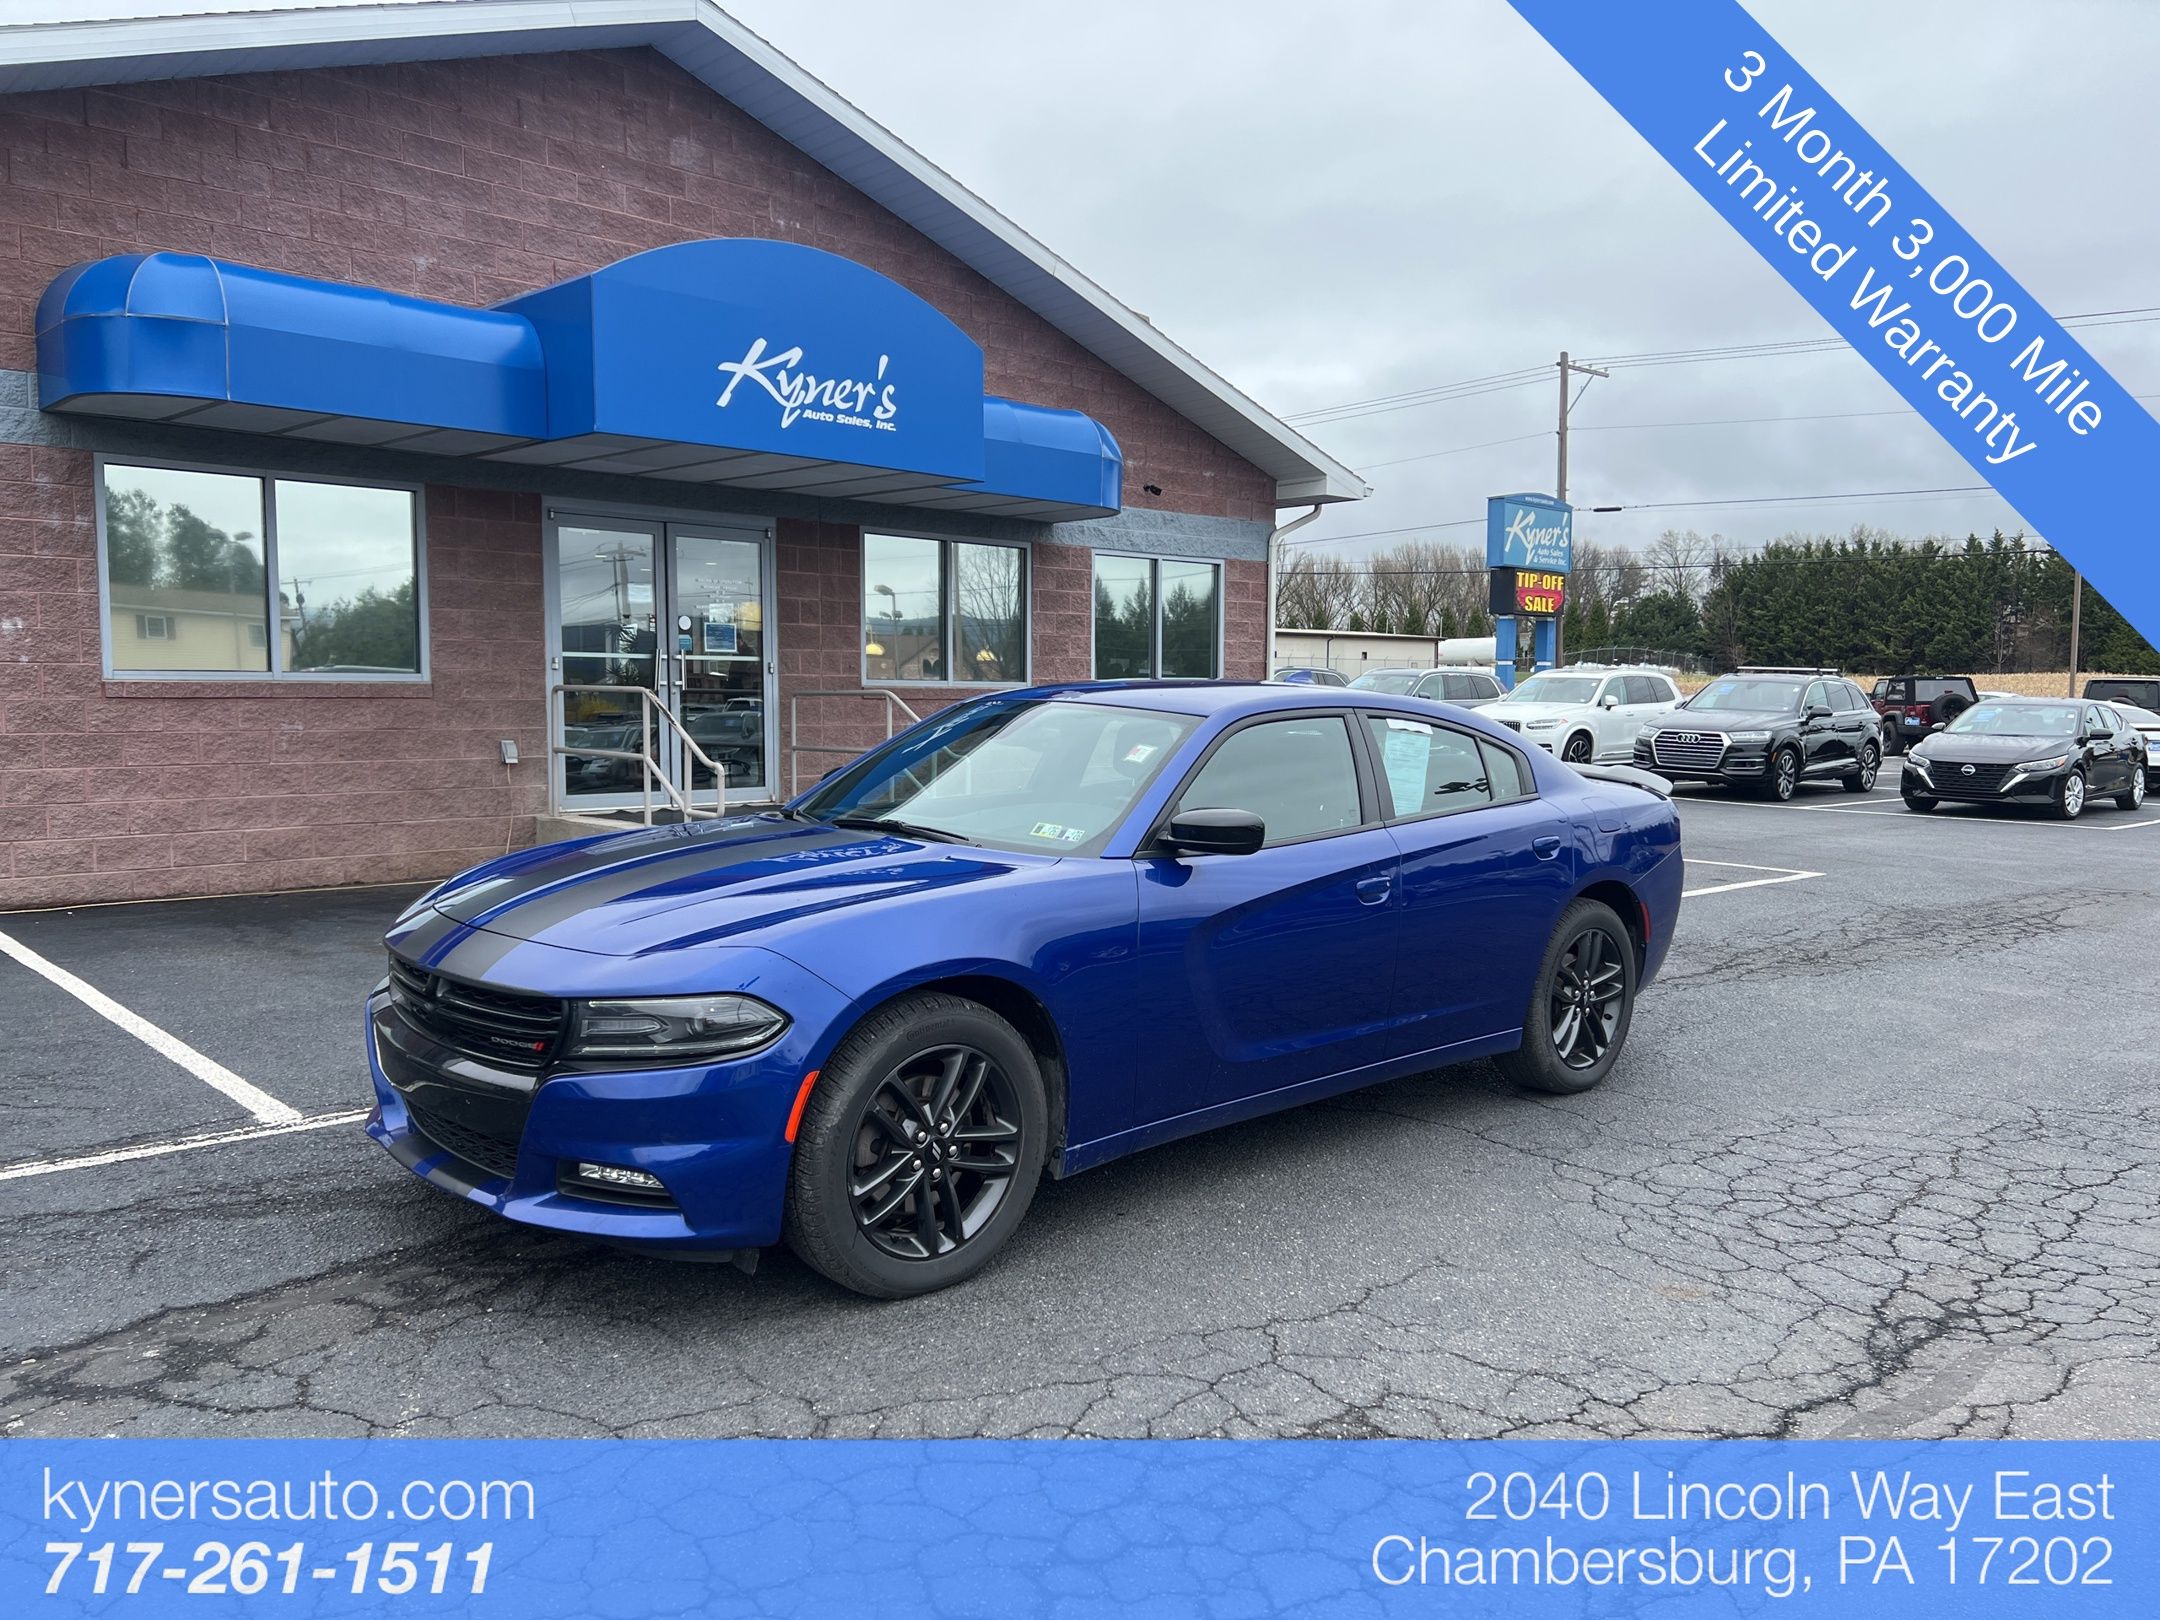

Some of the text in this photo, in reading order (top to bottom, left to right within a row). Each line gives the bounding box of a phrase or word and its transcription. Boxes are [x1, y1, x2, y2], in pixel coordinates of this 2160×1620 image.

[716, 337, 897, 429] Kyner's
[802, 409, 897, 432] Auto Sales, Inc.
[1505, 509, 1569, 565] Kyner's
[1550, 549, 1564, 558] Sales
[1516, 572, 1564, 591] TIP-OFF
[1525, 595, 1555, 613] SALE
